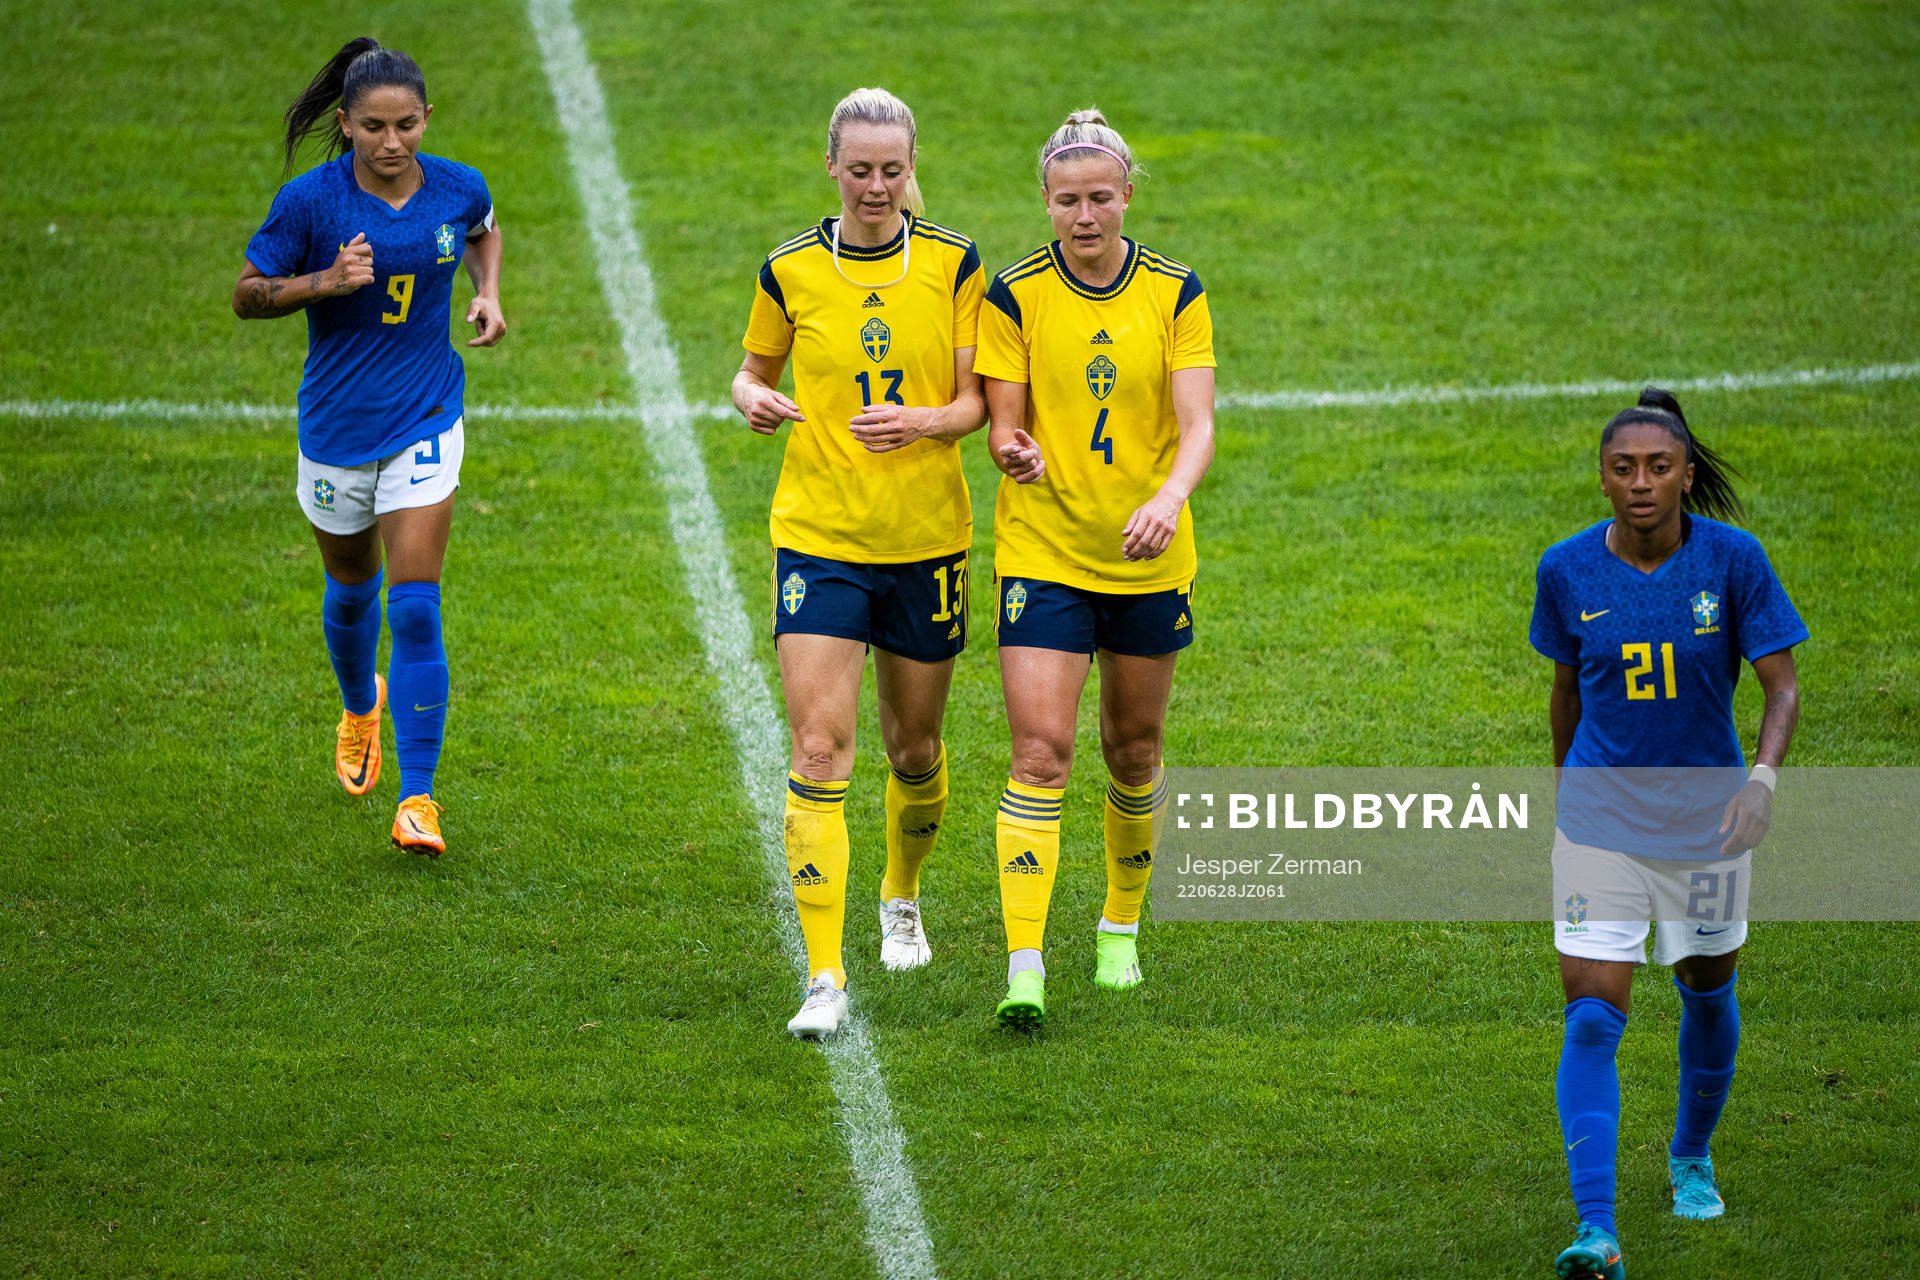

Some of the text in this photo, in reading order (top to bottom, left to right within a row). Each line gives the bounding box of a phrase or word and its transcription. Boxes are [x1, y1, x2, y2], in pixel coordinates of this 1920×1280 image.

[382, 274, 415, 324] 9
[862, 300, 885, 308] adidas
[1090, 408, 1113, 465] 4
[314, 502, 336, 513] BRASIL
[931, 558, 966, 622] 13
[1621, 642, 1677, 700] 21
[1004, 863, 1044, 875] adidas
[1117, 856, 1151, 869] adida
[1687, 870, 1737, 922] 21
